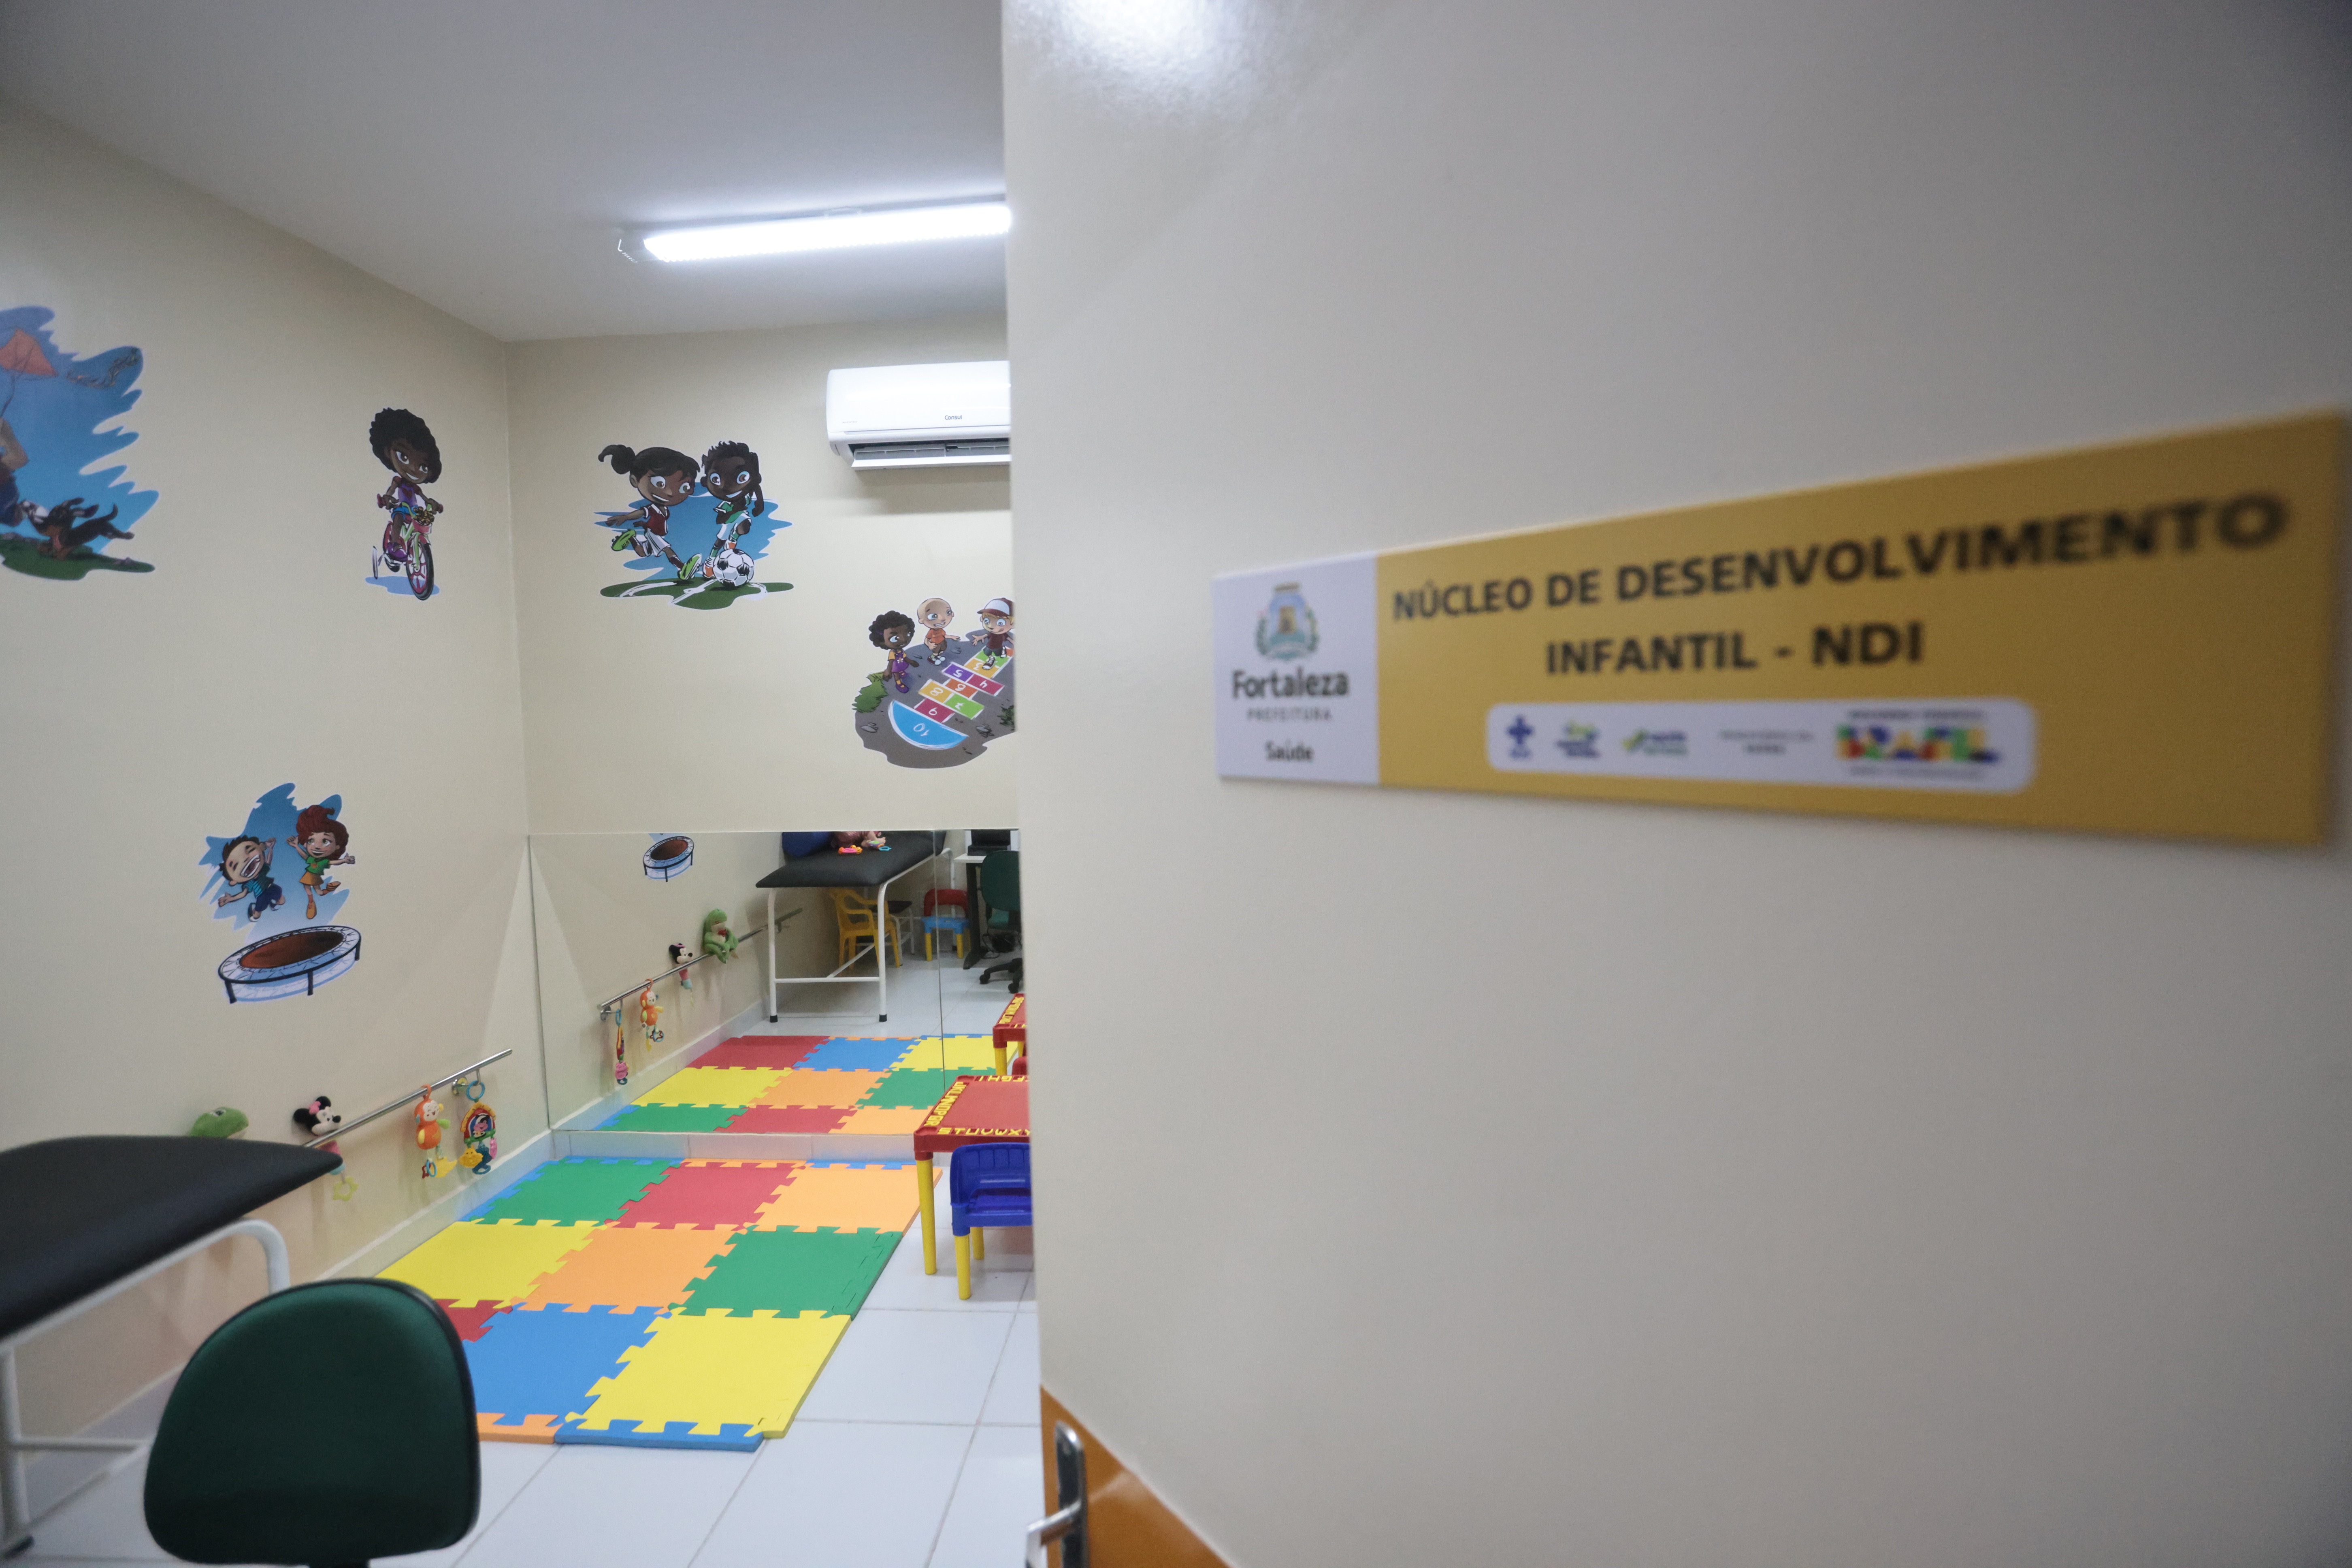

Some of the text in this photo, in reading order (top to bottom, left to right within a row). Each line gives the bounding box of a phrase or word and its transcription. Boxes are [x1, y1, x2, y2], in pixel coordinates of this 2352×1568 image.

[1392, 491, 2289, 621] NÚCLEO DE DESENVOLVIMENTO
[1546, 631, 1758, 675] INFANTIL
[1811, 621, 1924, 666] NDI
[953, 669, 964, 678] 5
[979, 680, 988, 688] 4
[1232, 666, 1349, 699] Fortaleza
[930, 687, 944, 696] 8
